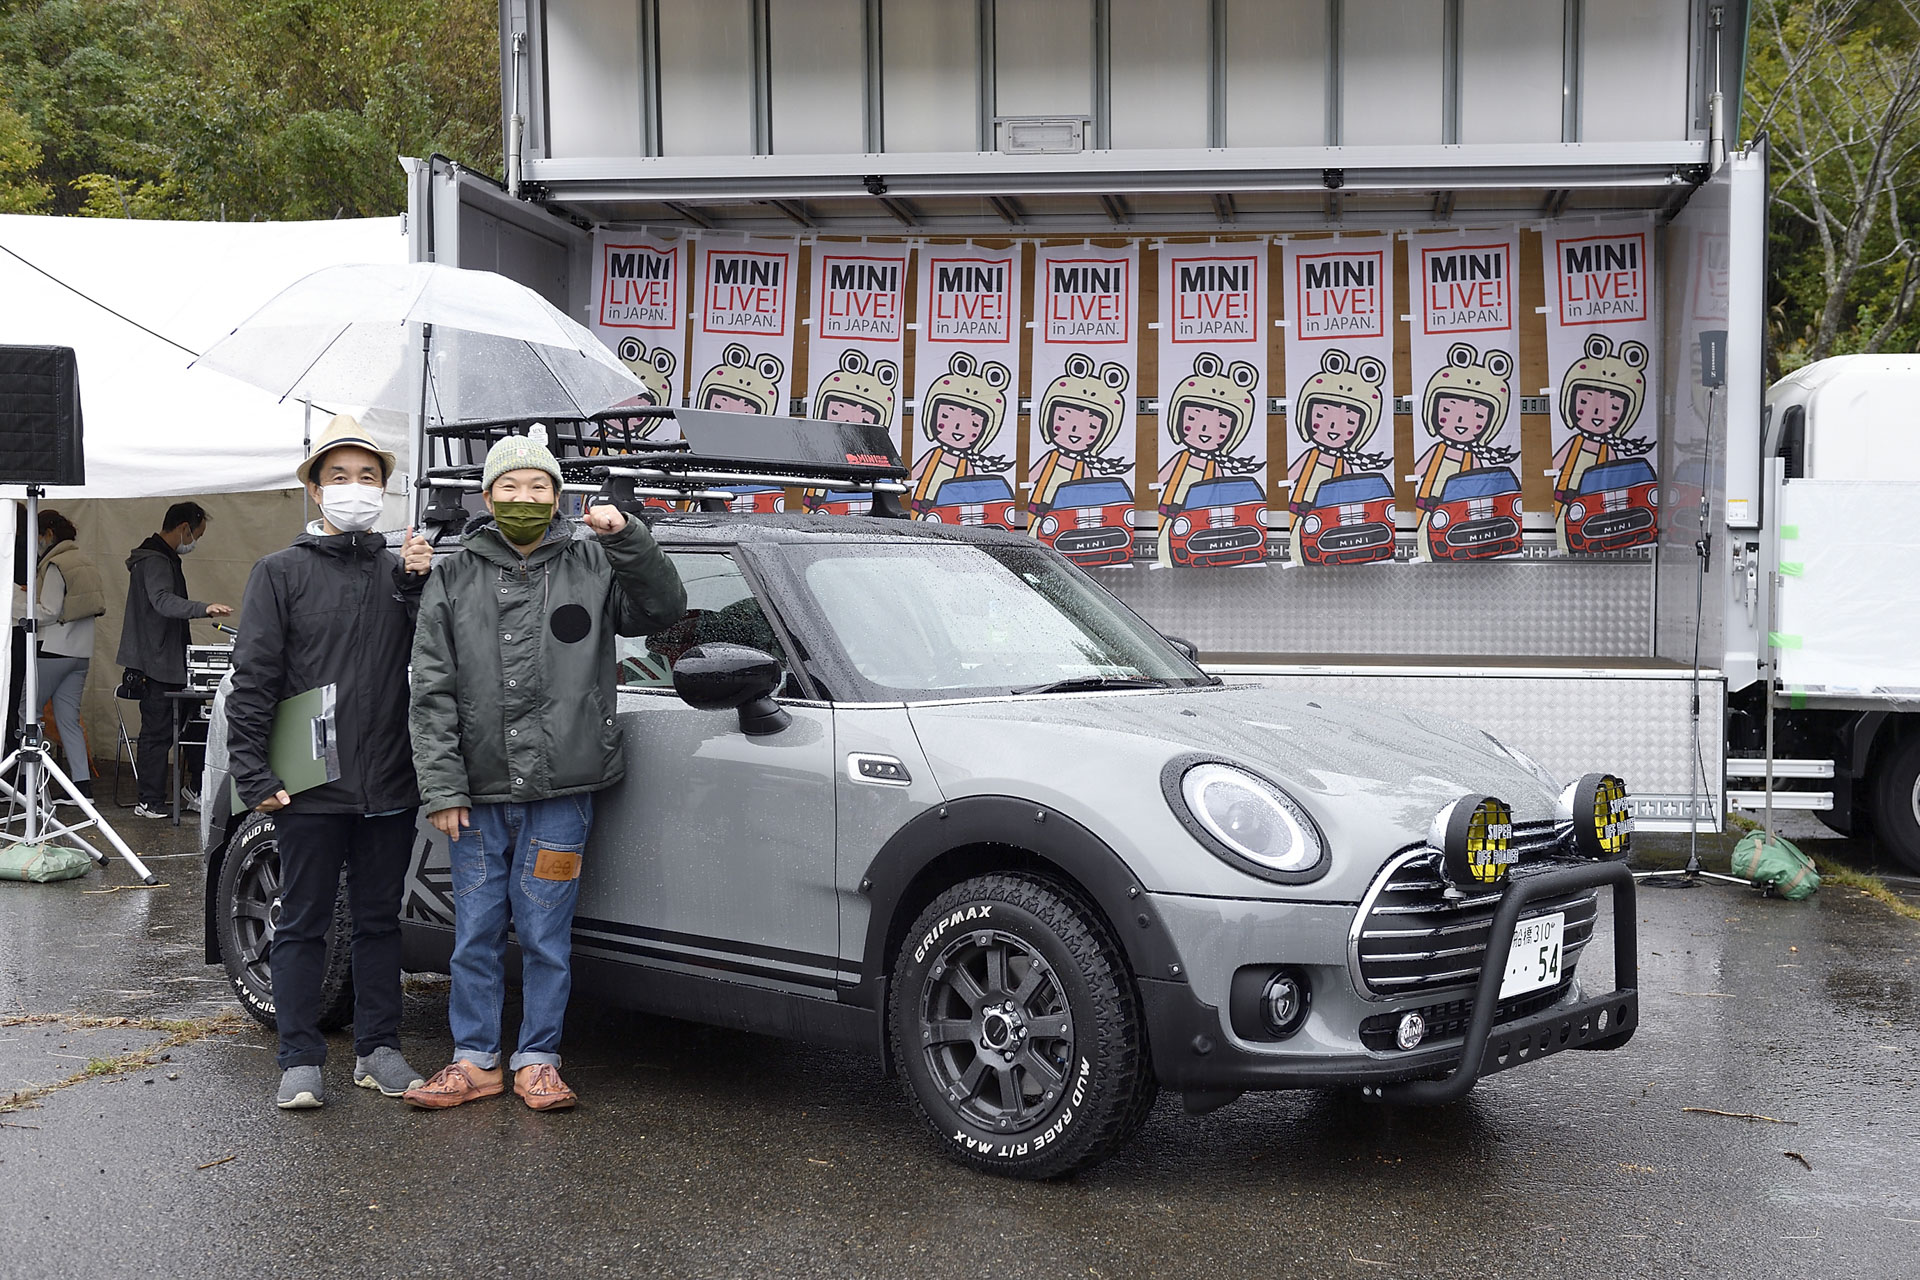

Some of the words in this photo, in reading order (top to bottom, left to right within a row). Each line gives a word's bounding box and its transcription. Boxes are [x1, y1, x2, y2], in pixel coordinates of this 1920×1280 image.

[611, 253, 670, 280] MINI
[1431, 253, 1501, 283] MINI
[1566, 243, 1637, 274] MINI
[714, 259, 780, 287] MINI
[831, 265, 897, 292] MINI
[938, 267, 1003, 293] MINI
[1054, 267, 1121, 293] MINI
[1180, 265, 1249, 293] MINI
[1305, 261, 1374, 289] MINI
[610, 280, 668, 307] LIVE!
[713, 286, 777, 313] LIVE!
[1432, 281, 1502, 310] LIVE!
[1567, 271, 1638, 302] LIVE!
[608, 306, 621, 320] in
[624, 307, 667, 321] JAPAN.
[829, 292, 895, 319] LIVE!
[937, 294, 1002, 320] LIVE!
[1053, 295, 1120, 321] LIVE!
[1180, 293, 1248, 320] LIVE!
[1306, 288, 1374, 317] LIVE!
[1568, 304, 1582, 317] in
[1586, 299, 1638, 316] JAPAN.
[711, 312, 724, 325] in
[728, 313, 777, 328] JAPAN.
[828, 318, 841, 331] in
[844, 319, 894, 334] JAPAN.
[936, 321, 949, 334] in
[953, 321, 1001, 335] JAPAN.
[1052, 322, 1066, 335] in
[1069, 322, 1120, 336] JAPAN.
[1180, 322, 1193, 335] in
[1197, 321, 1248, 334] JAPAN.
[1306, 318, 1320, 332] in
[1324, 316, 1375, 331] JAPAN.
[1432, 312, 1446, 325] in
[1450, 309, 1503, 325] JAPAN.
[1469, 531, 1497, 542] MINI
[1603, 522, 1632, 534] MINI
[1076, 540, 1106, 550] MINI
[1209, 540, 1239, 550] MINI
[1338, 536, 1370, 547] MINI
[241, 825, 262, 848] MUD
[1487, 823, 1512, 840] SUPER
[539, 854, 571, 875] Lee
[1476, 849, 1491, 866] OFF
[914, 904, 992, 964] GRIPMAX
[235, 976, 276, 1013] RIPMAX
[1073, 1056, 1091, 1108] MUD
[954, 1129, 994, 1155] MAX
[1033, 1107, 1074, 1152] RAGE
[998, 1141, 1029, 1159] R/T
